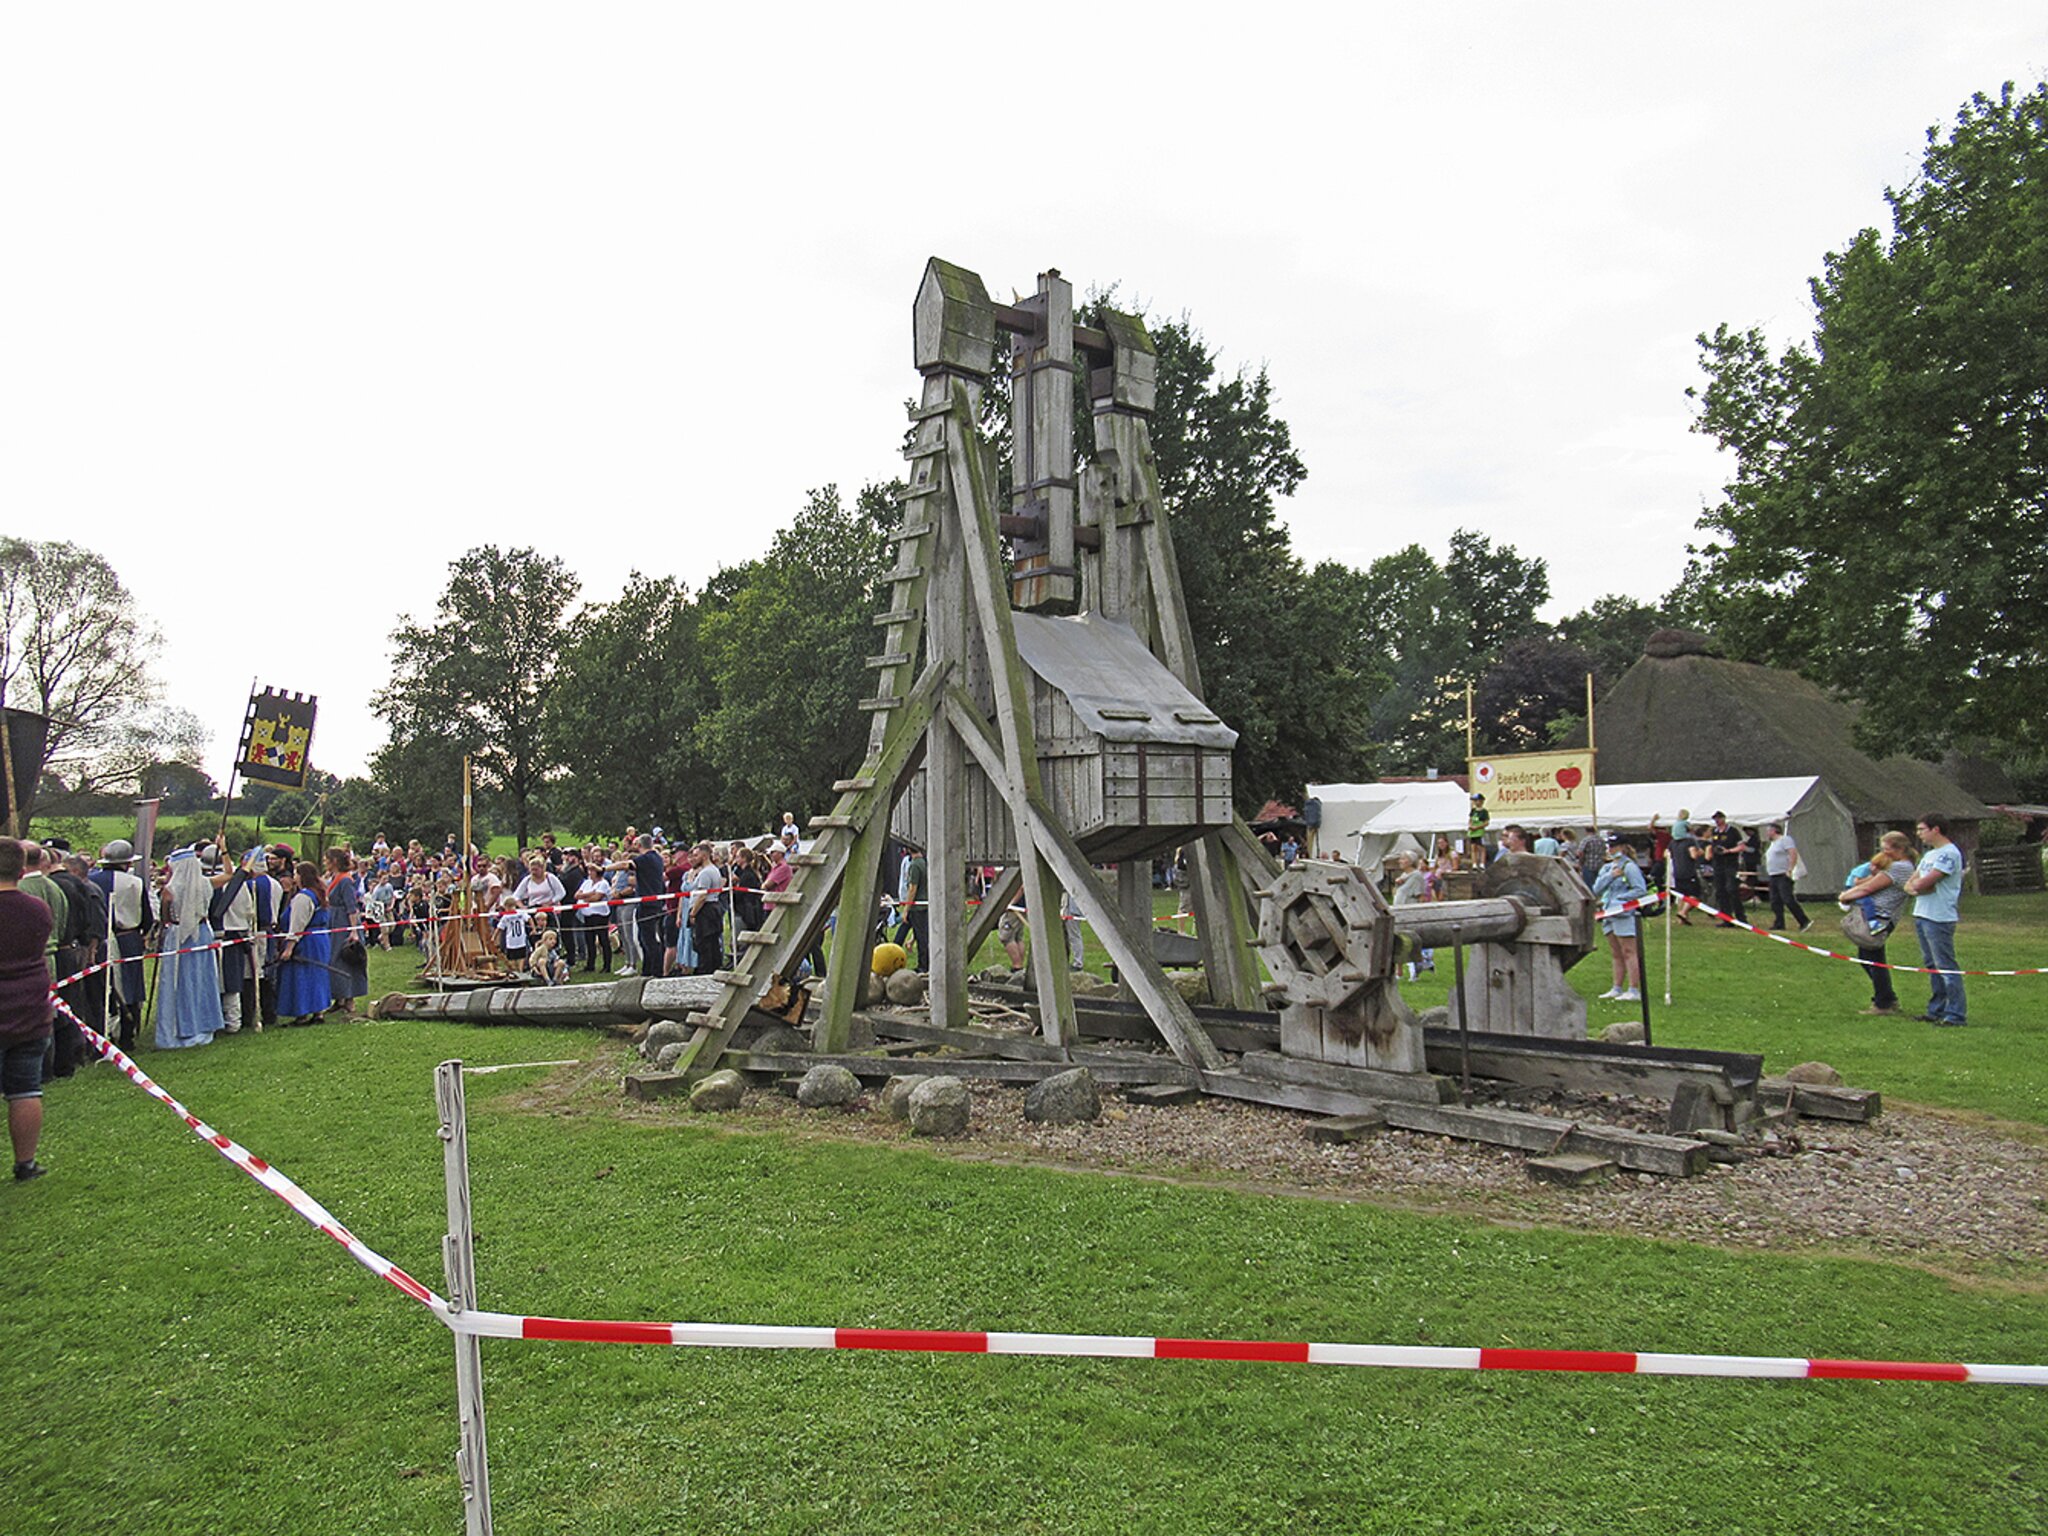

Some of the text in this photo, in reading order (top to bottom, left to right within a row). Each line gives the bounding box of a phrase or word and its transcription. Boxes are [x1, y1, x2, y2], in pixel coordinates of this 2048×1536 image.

[1497, 771, 1550, 785] Beekdorper
[1498, 786, 1559, 804] Appelboom
[510, 920, 522, 938] 10
